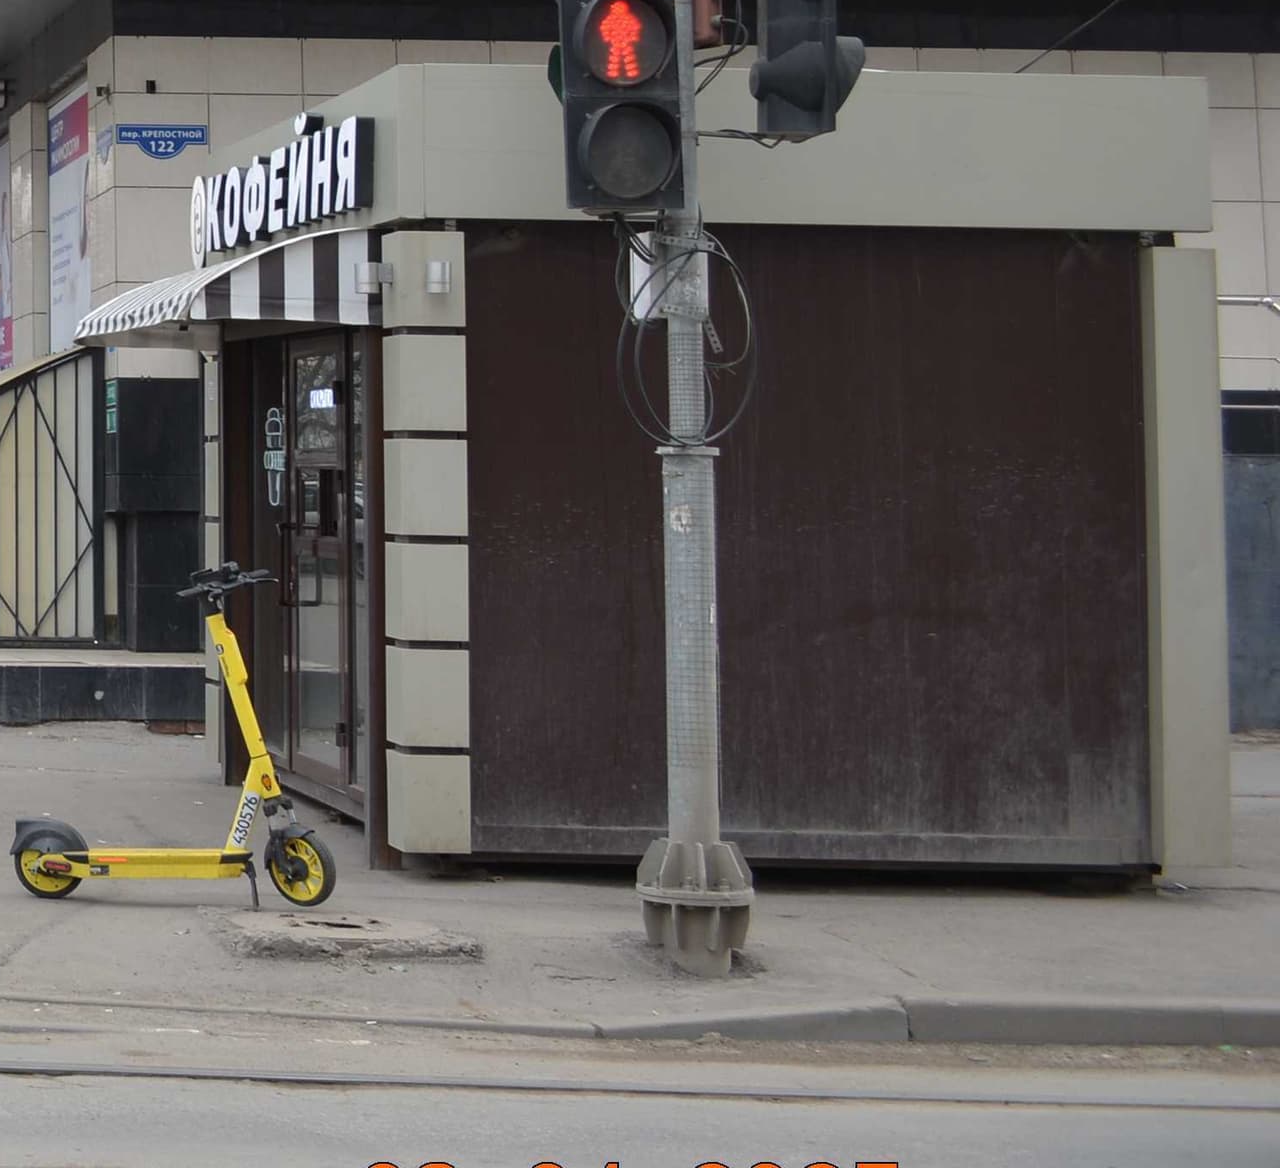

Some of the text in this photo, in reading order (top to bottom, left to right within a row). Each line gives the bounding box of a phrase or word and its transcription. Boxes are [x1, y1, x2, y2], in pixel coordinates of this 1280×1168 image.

[121, 130, 203, 140] пер. КРЕПОСТНОЙ
[149, 141, 175, 153] 122
[206, 112, 358, 252] КОФЕЙНЯ
[232, 796, 258, 844] 430576
